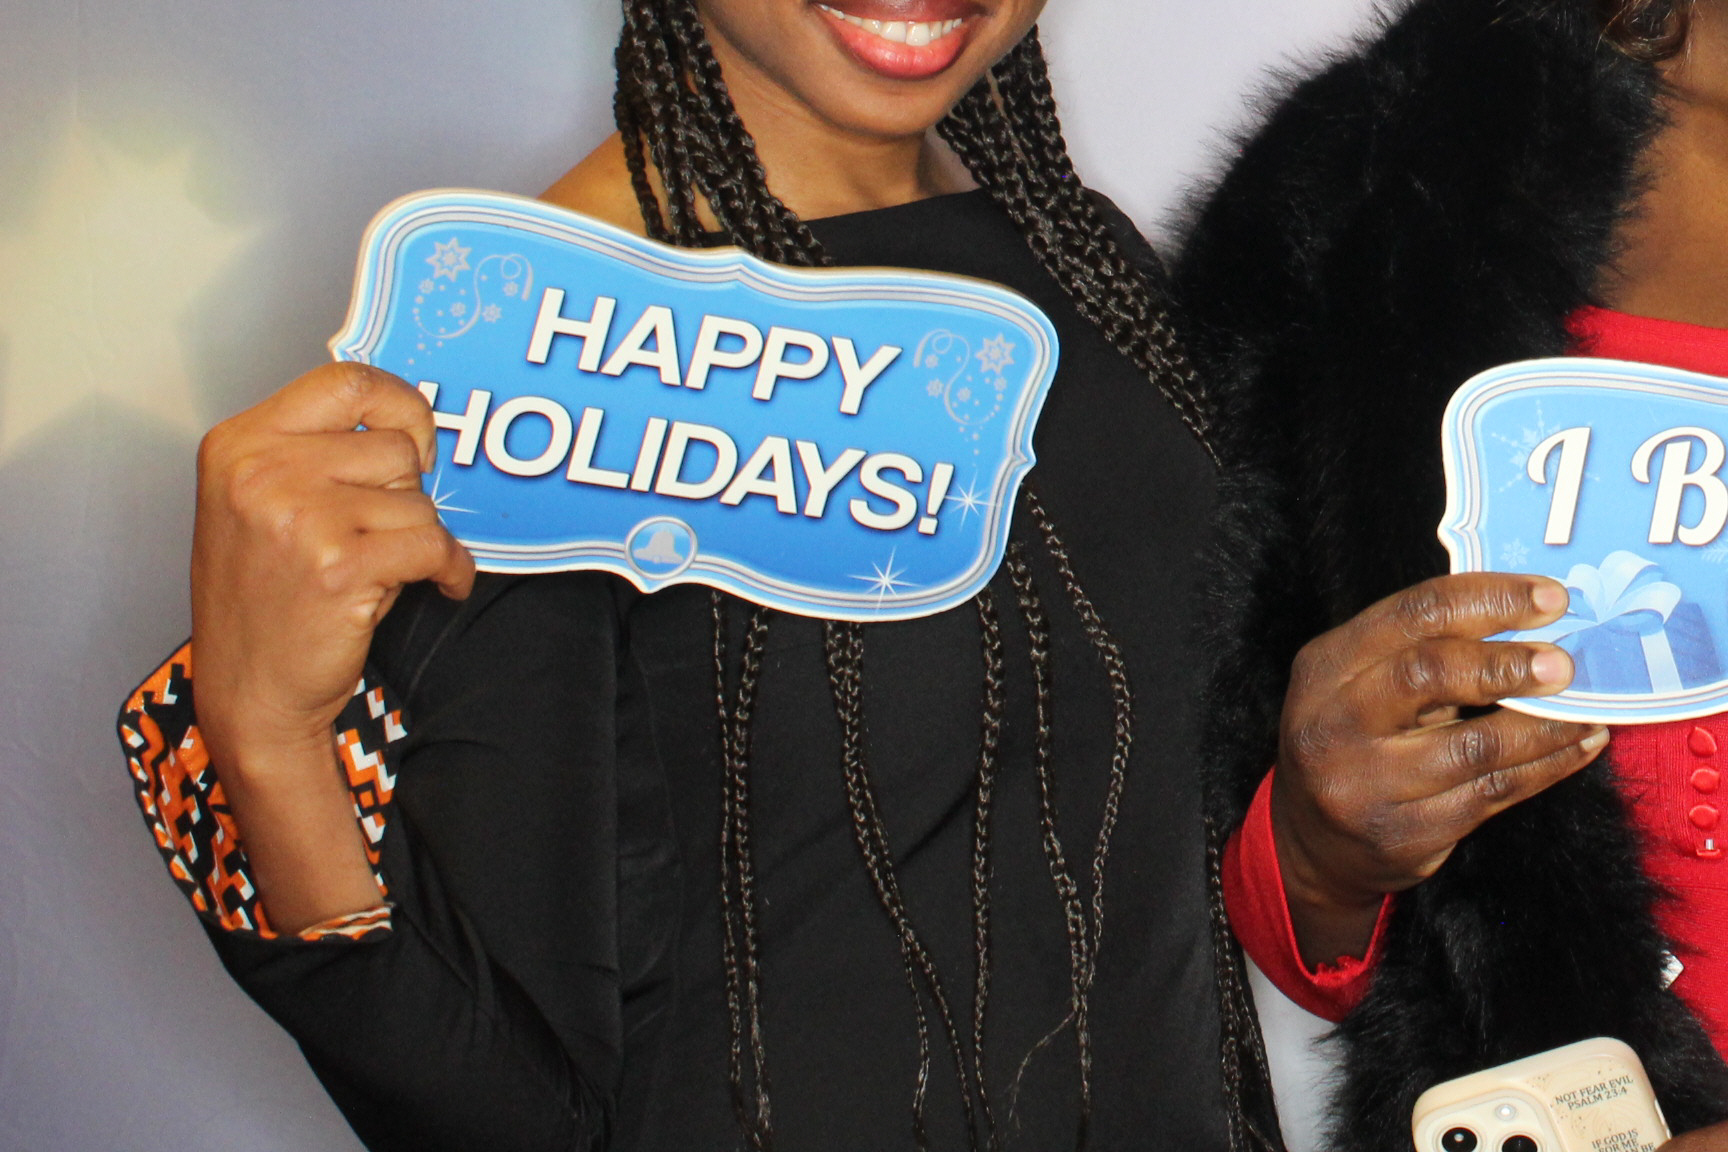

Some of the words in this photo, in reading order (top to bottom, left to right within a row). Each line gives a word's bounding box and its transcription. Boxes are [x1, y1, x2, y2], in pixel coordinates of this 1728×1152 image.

[526, 287, 902, 415] HAPPY
[418, 380, 955, 536] HOLIDAYS!
[1526, 426, 1592, 546] I
[1555, 1091, 1578, 1105] NOT
[1579, 1082, 1607, 1097] FEAR
[1608, 1075, 1634, 1089] EVIL
[1567, 1093, 1604, 1110] PSALM
[1605, 1086, 1628, 1100] 23:4
[1591, 1139, 1602, 1149] IF
[1603, 1132, 1627, 1146] GOD
[1627, 1128, 1639, 1139] IS
[1621, 1139, 1640, 1150] ME
